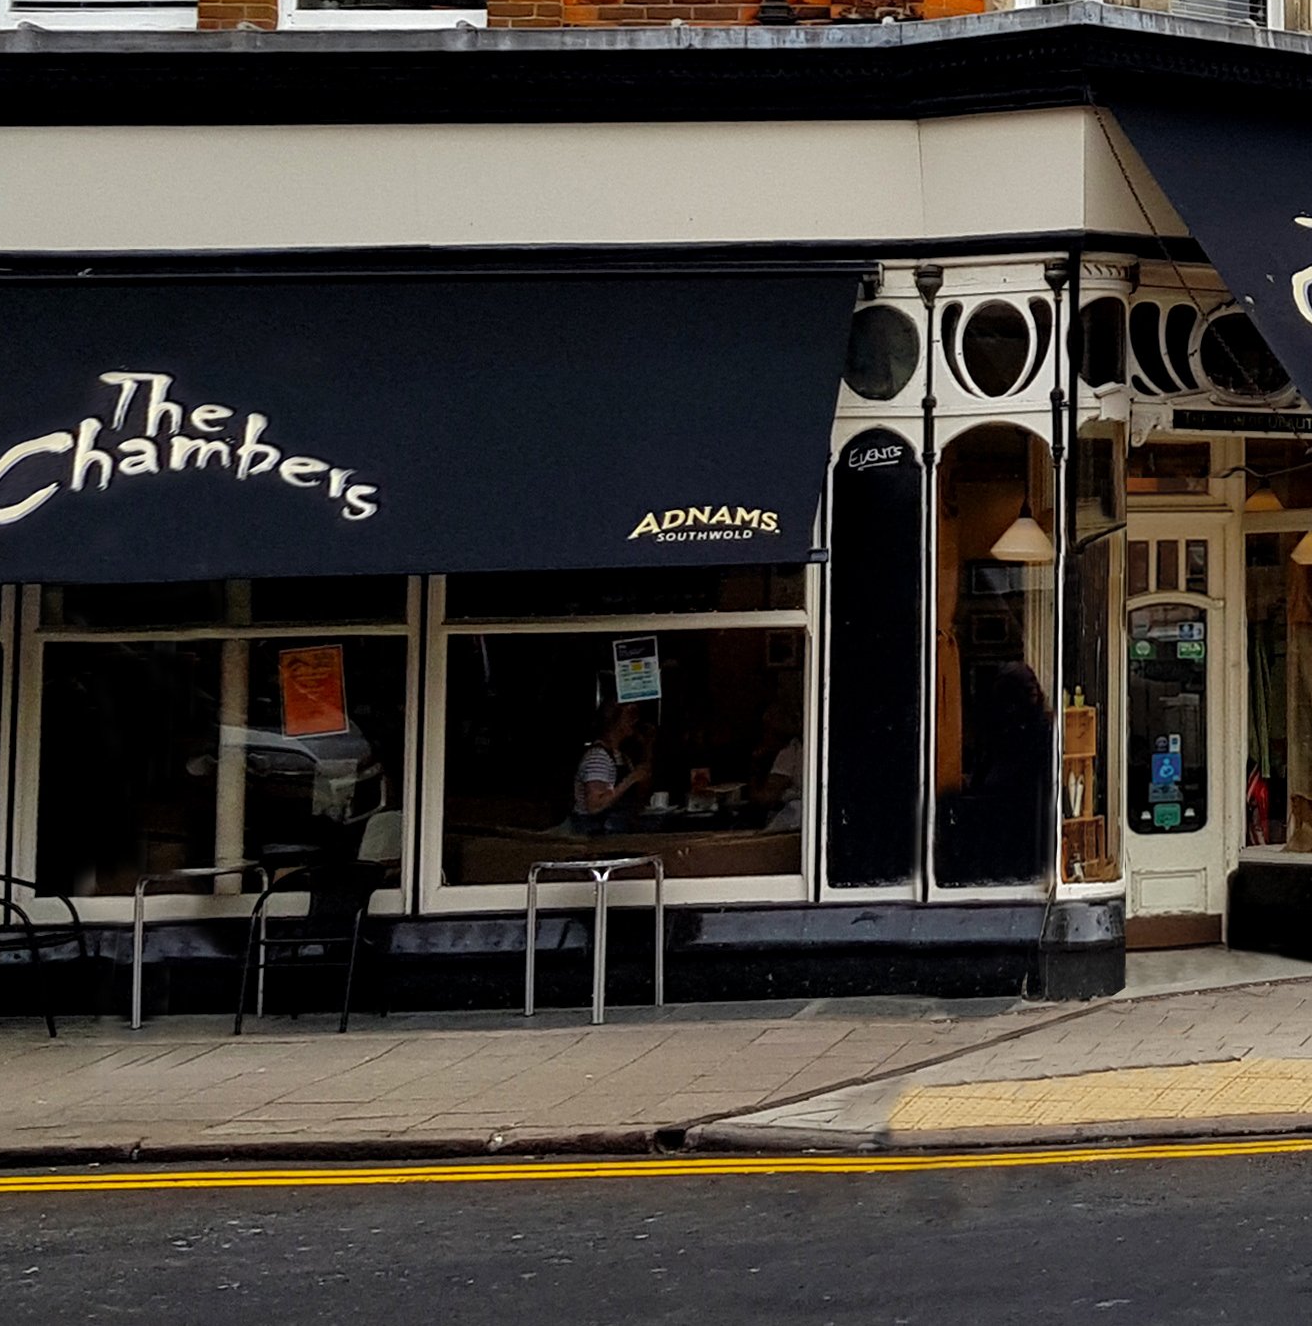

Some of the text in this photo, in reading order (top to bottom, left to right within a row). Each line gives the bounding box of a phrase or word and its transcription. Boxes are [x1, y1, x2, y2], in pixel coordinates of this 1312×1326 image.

[98, 370, 236, 438] The
[626, 505, 780, 540] ADNAMS
[655, 528, 754, 543] SOUTHWOLD
